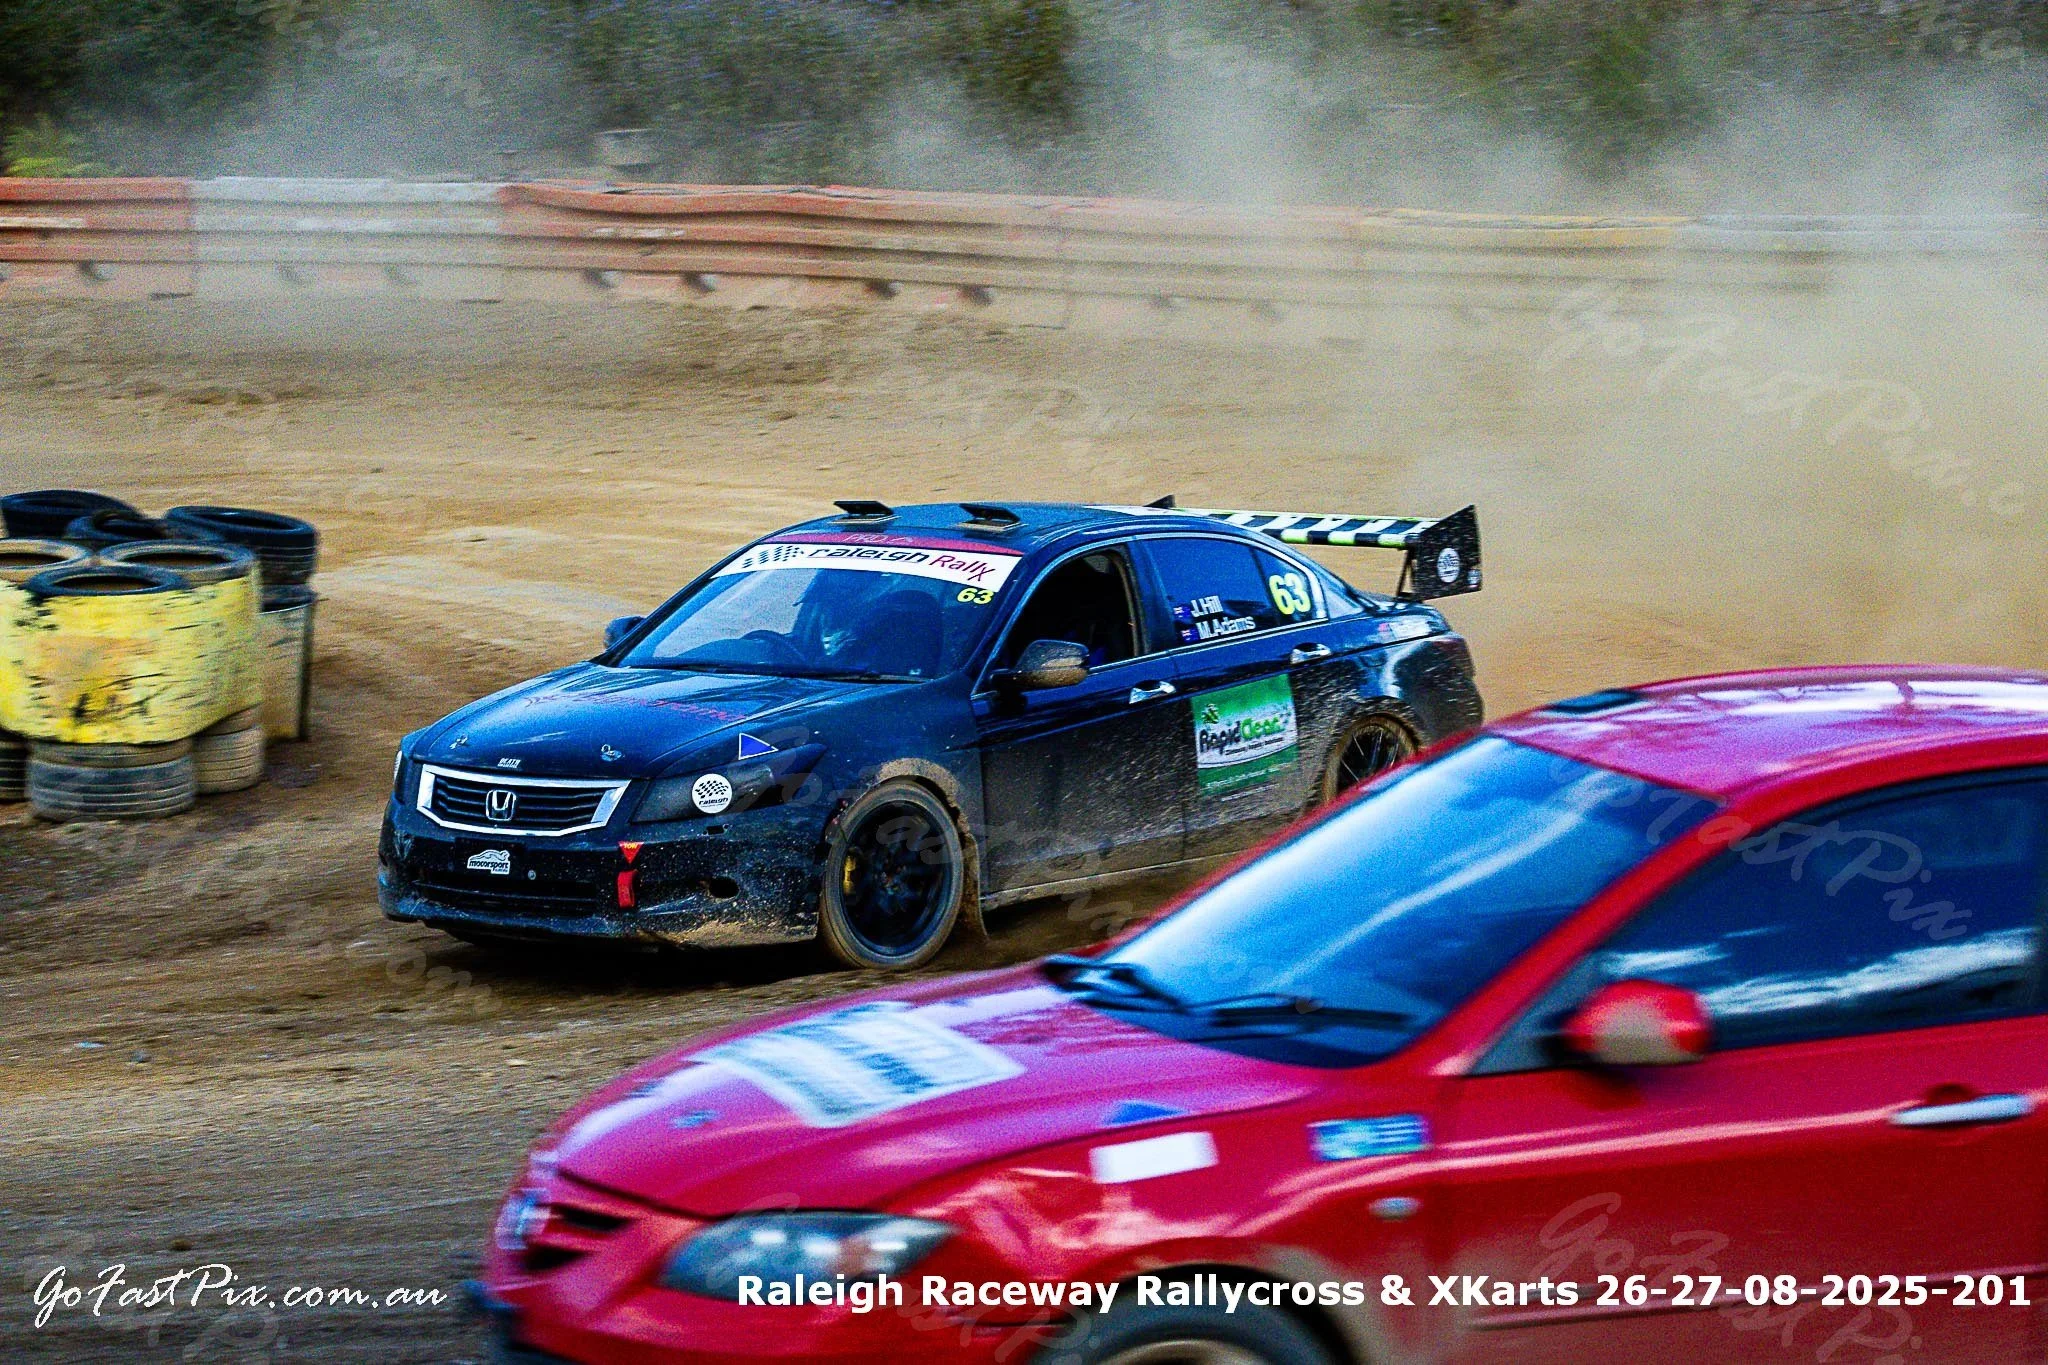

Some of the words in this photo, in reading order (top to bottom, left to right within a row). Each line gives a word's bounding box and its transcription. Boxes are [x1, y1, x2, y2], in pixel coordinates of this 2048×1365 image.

[808, 547, 930, 564] raleigh
[928, 554, 996, 583] Rally
[956, 587, 995, 606] 63
[1268, 572, 1312, 616] 63
[1195, 615, 1257, 641] M.Adams
[698, 797, 729, 806] raleigh
[468, 860, 509, 873] motorsport
